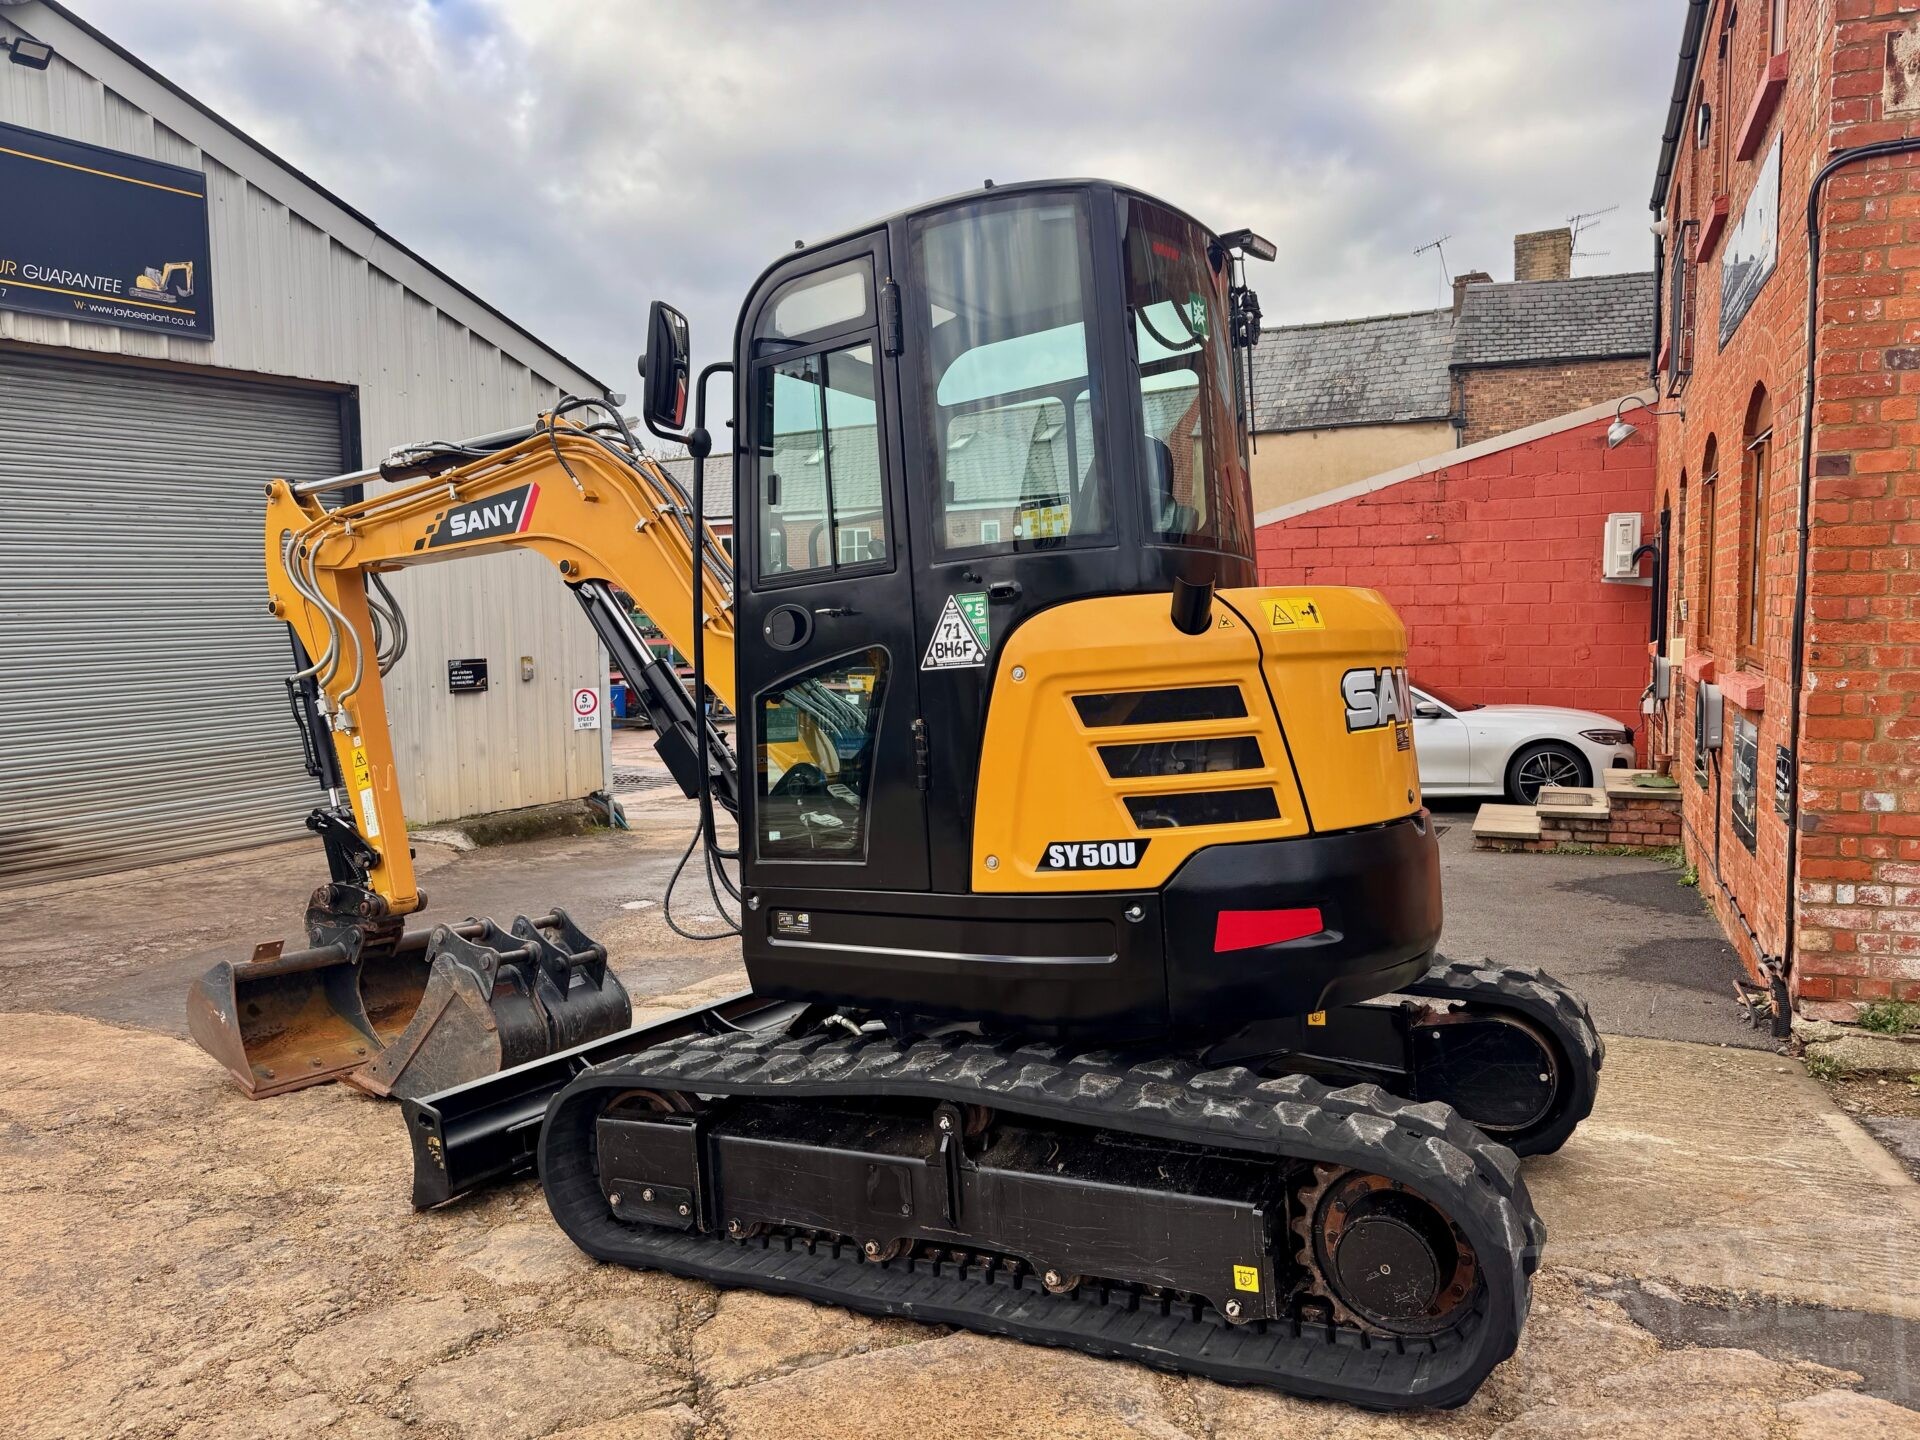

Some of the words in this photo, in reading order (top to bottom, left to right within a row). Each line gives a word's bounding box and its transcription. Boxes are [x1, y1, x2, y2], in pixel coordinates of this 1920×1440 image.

[22, 264, 123, 294] GUARANTEE
[74, 300, 87, 311] W:
[89, 304, 197, 328] www.jaybeeplant.co.uk
[449, 500, 518, 537] SANY
[974, 602, 985, 617] 5
[943, 623, 962, 640] 71
[935, 640, 972, 659] BH6F
[581, 694, 588, 704] 5
[1341, 666, 1412, 733] SAN
[1048, 842, 1137, 868] SY50U
